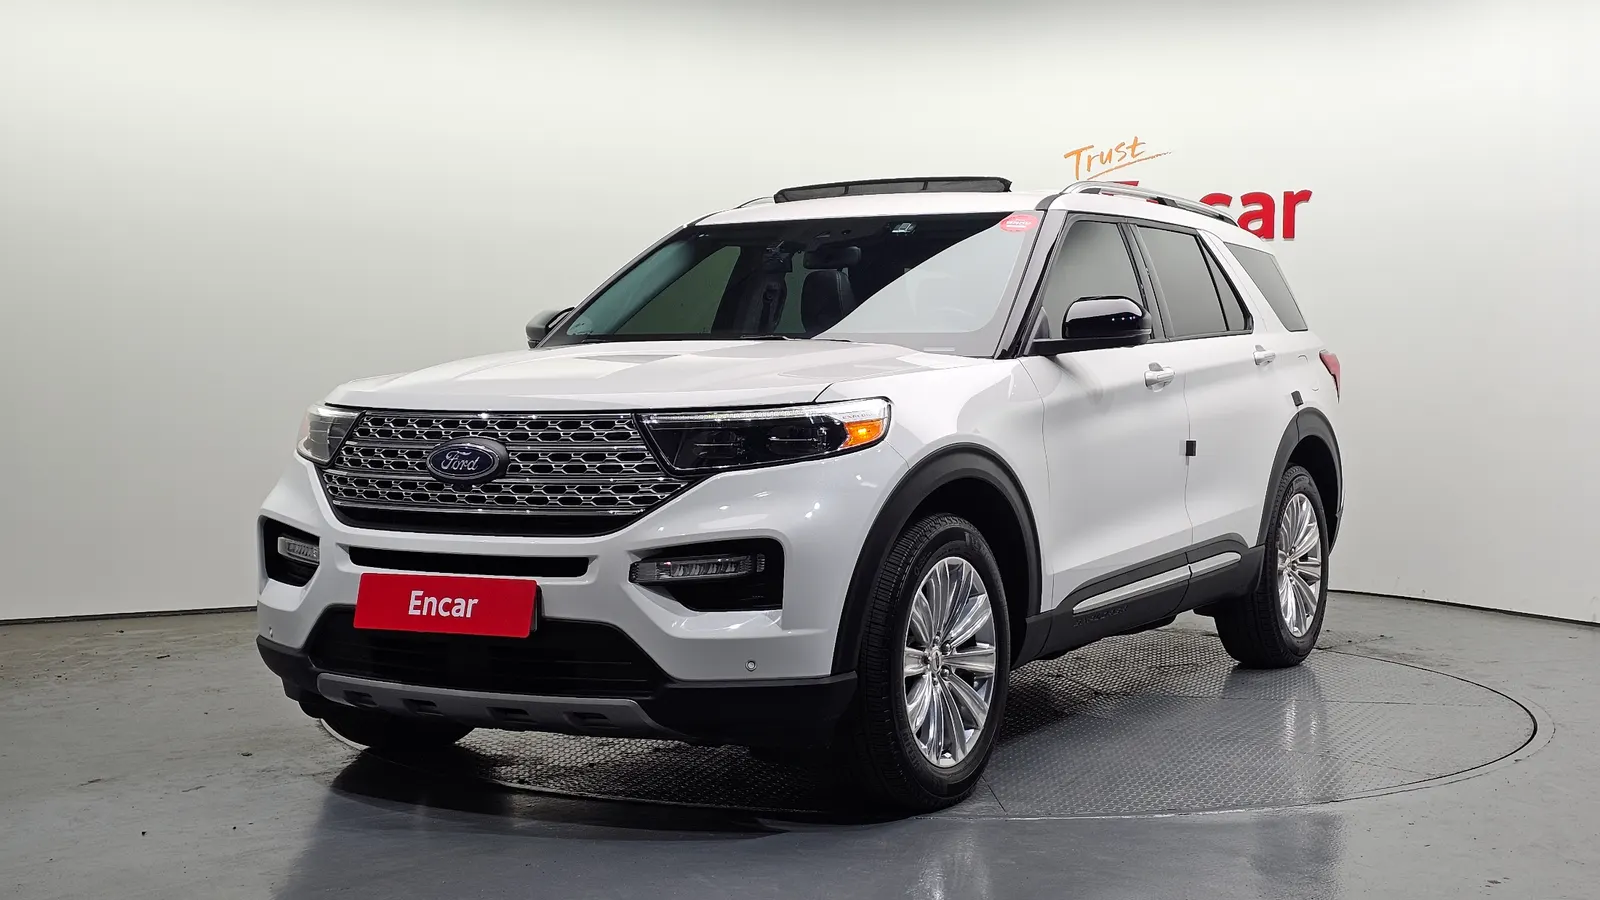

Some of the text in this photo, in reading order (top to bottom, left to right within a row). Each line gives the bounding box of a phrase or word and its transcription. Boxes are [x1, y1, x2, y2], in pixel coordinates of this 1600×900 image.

[1063, 136, 1146, 180] Trust
[440, 450, 480, 471] Ford
[408, 590, 479, 618] Encar
